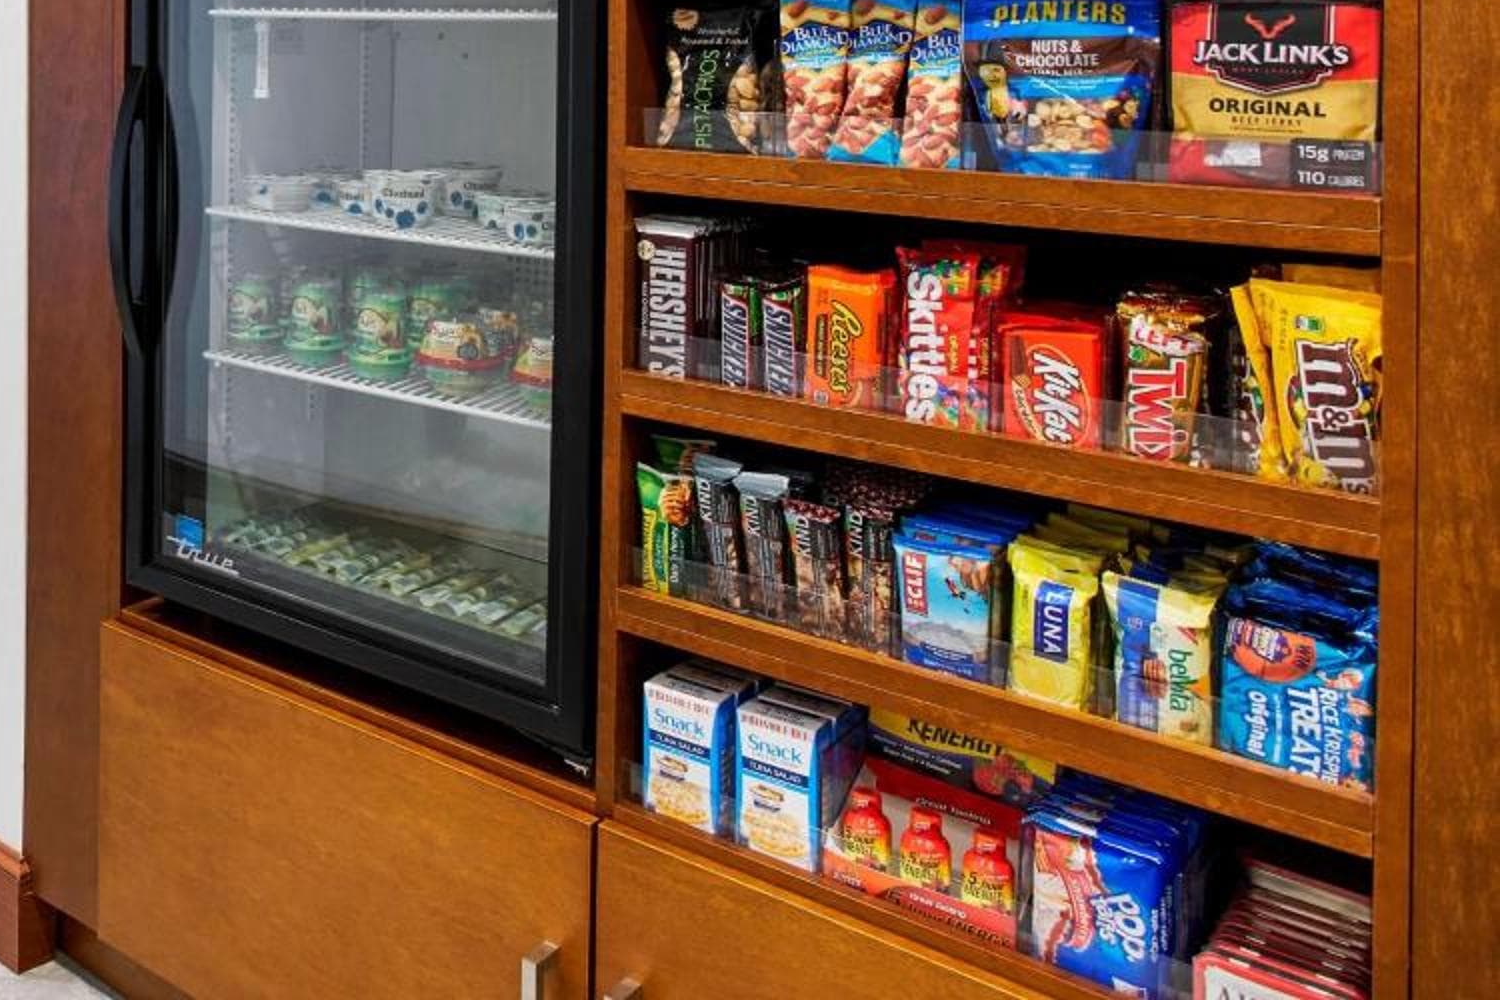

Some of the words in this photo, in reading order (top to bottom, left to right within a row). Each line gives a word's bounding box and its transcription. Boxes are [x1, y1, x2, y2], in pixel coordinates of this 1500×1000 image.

[993, 0, 1127, 26] PLANTERS
[779, 31, 850, 55] DIAMOND
[794, 26, 830, 41] BLUE
[859, 23, 893, 38] BLUE
[928, 34, 961, 49] BLU
[1031, 39, 1068, 53] NUTS
[1070, 39, 1083, 53] &
[910, 46, 961, 61] DIAMO
[1015, 53, 1101, 67] CHOCOLATE
[1192, 40, 1262, 65] JACK
[695, 49, 720, 148] PISTACHIOS
[1208, 97, 1328, 119] ORIGINAL
[1297, 144, 1330, 163] 15g
[1297, 170, 1326, 186] 110
[649, 245, 687, 381] HERSHEY'S
[722, 299, 748, 387] SNICKER
[764, 305, 794, 396] SNICKER
[905, 270, 948, 424] Skittles
[699, 477, 713, 522] KIND
[746, 494, 761, 538] KIND
[795, 514, 811, 558] KIND
[849, 510, 864, 558] KIND
[905, 554, 925, 598] CLIF
[1043, 590, 1065, 656] LUNA
[1318, 687, 1342, 723] RICE
[653, 707, 706, 738] Snack
[1246, 690, 1270, 756] Original
[747, 733, 802, 764] Snack
[1319, 727, 1342, 786] KRISPIE
